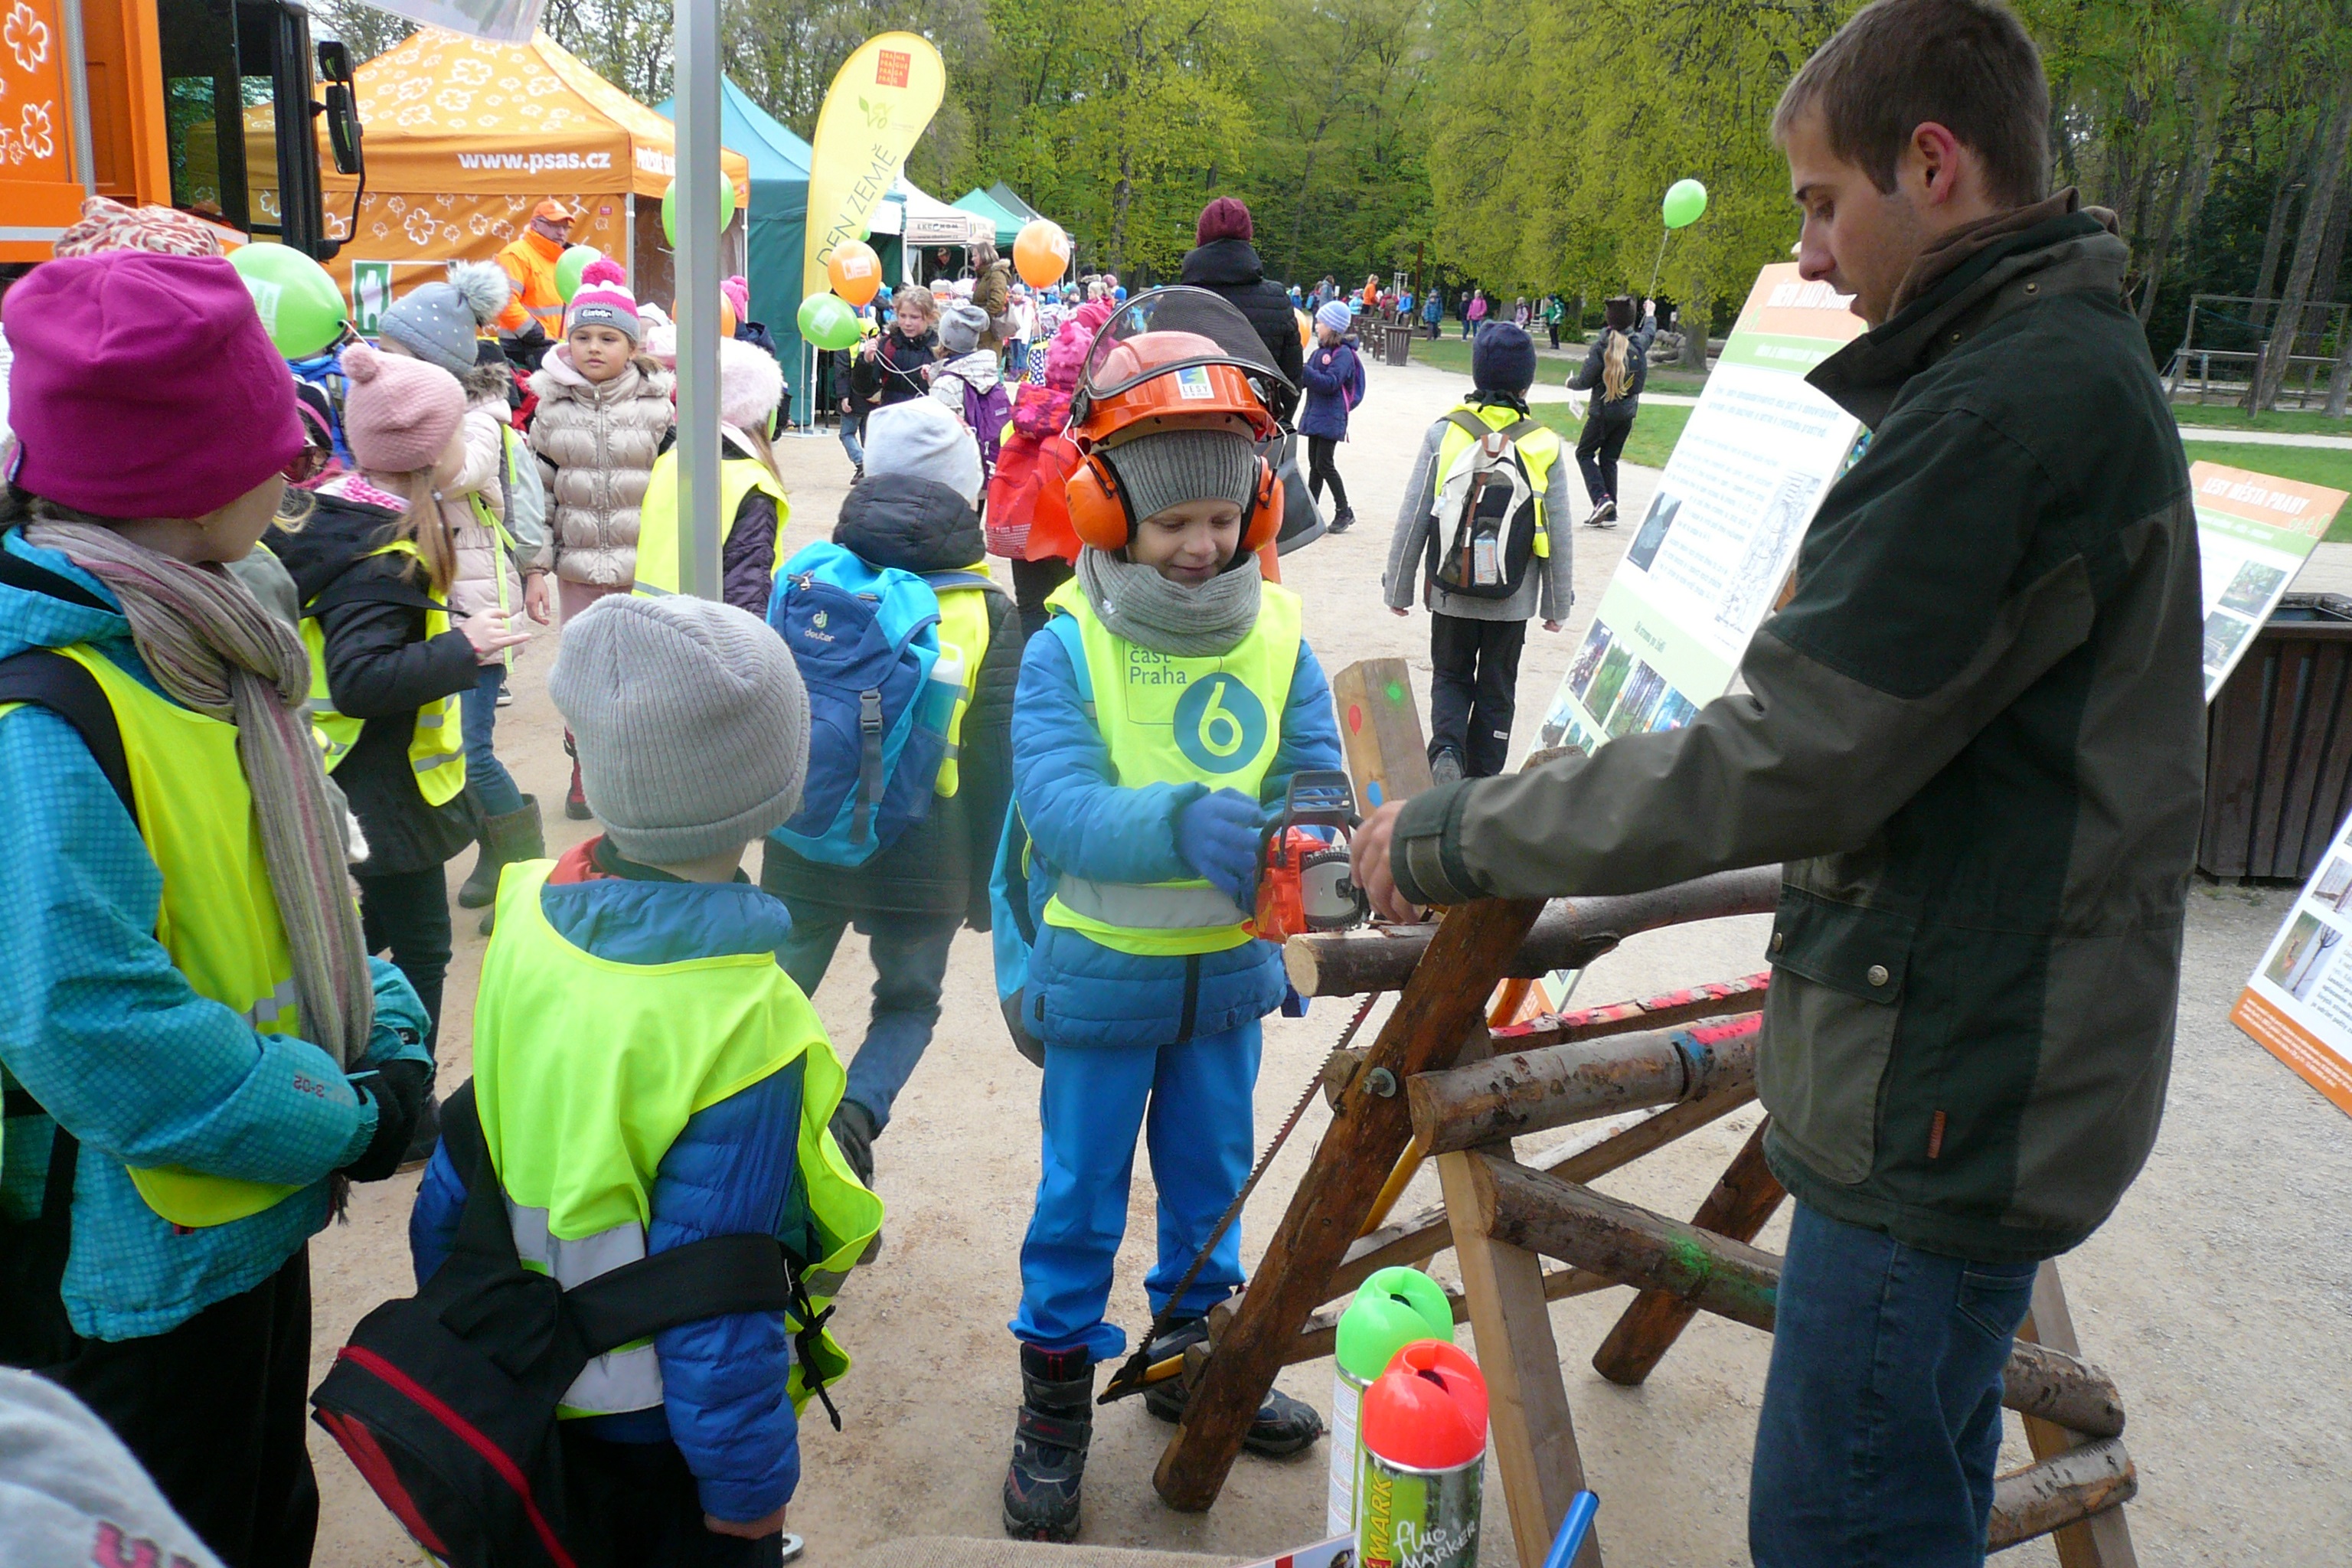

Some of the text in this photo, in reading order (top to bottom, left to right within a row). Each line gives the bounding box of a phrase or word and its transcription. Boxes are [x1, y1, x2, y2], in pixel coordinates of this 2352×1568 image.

[458, 152, 611, 174] www.psas.cz
[816, 214, 856, 266] DEN
[847, 143, 897, 214] ZEMĚ
[1182, 384, 1208, 393] LESY
[2201, 477, 2311, 515] LESY MĚSTA PRAHY
[804, 627, 835, 643] deuter
[1130, 665, 1187, 684] Praha
[1198, 681, 1243, 757] 6
[1402, 1520, 1476, 1568] MARKER
